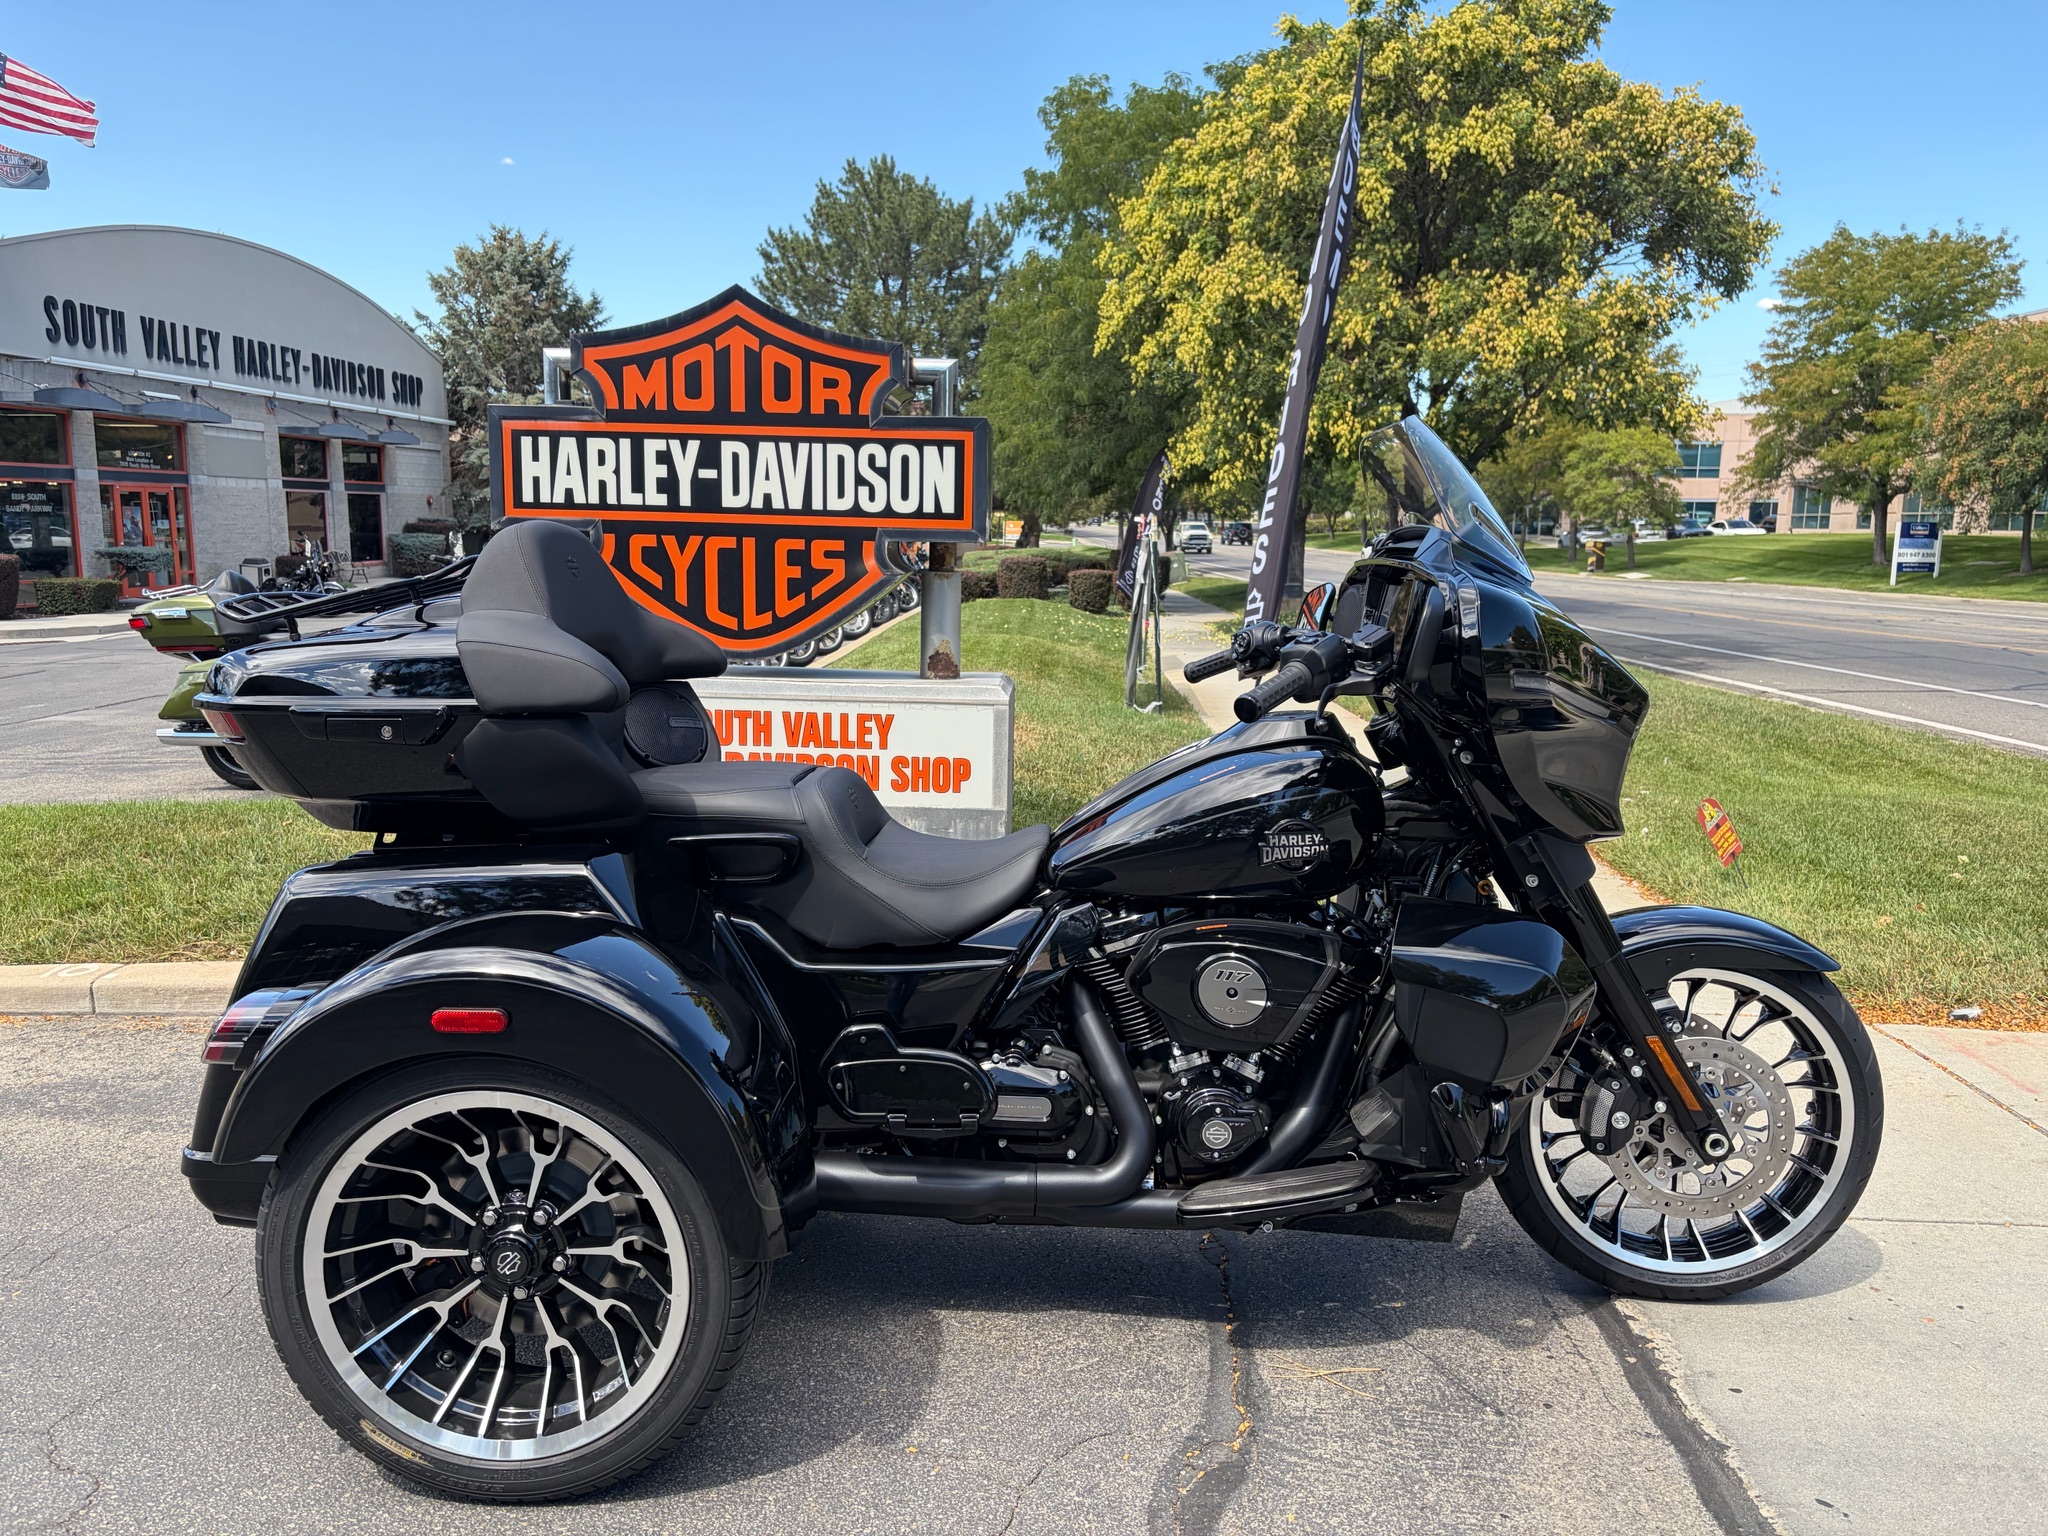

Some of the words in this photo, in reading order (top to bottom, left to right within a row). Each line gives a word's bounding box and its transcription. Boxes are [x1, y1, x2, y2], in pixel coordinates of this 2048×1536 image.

[44, 295, 127, 355] SOUTH
[139, 315, 221, 370] VALLEY
[232, 335, 386, 401] HARLEY-DAVIDSON
[392, 371, 424, 407] SHOP
[622, 325, 852, 416] MOTOR
[520, 435, 956, 514] HARLEY-DAVIDSON
[1252, 348, 1302, 576] RIDES
[26, 504, 53, 512] PARKWAY
[27, 493, 47, 501] SOUTH
[629, 533, 846, 632] CYCLES
[706, 708, 773, 747] UTH
[782, 711, 895, 750] VALLEY
[890, 755, 972, 794] SHOP
[1262, 844, 1329, 864] DAVIDSON
[1268, 833, 1324, 847] HARLEY-
[1213, 968, 1254, 984] 117
